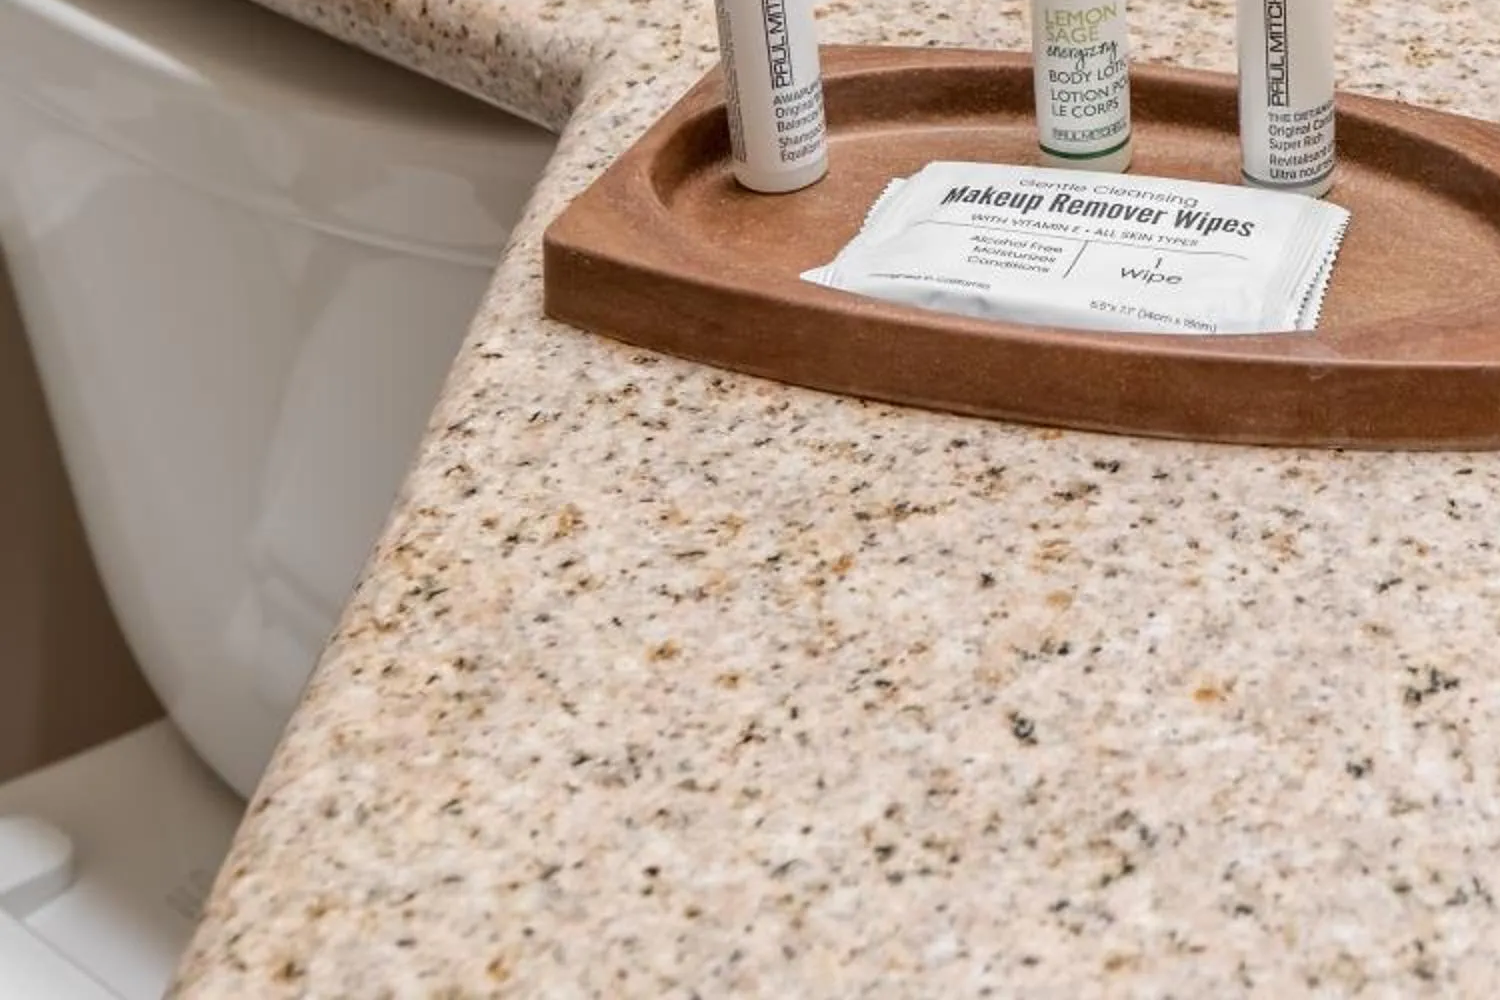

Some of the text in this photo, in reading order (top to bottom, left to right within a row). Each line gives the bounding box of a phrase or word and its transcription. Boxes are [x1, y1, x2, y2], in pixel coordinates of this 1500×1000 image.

[1044, 3, 1118, 27] LEMON
[1045, 26, 1100, 43] SAGE
[769, 36, 791, 89] PAUL
[1046, 40, 1118, 72] energizing
[1048, 69, 1092, 85] BODY
[1270, 56, 1286, 107] PAUL
[1051, 86, 1109, 103] LOTION
[1052, 97, 1119, 119] LE CORPS
[1268, 121, 1311, 138] Original
[1269, 137, 1301, 153] Super
[1269, 166, 1297, 180] Ultra
[1094, 184, 1199, 209] Cleansing
[941, 184, 1255, 238] Makeup Remover Wipes
[1095, 227, 1116, 239] ALL
[1121, 230, 1153, 243] SKIN
[1120, 267, 1183, 285] wipe
